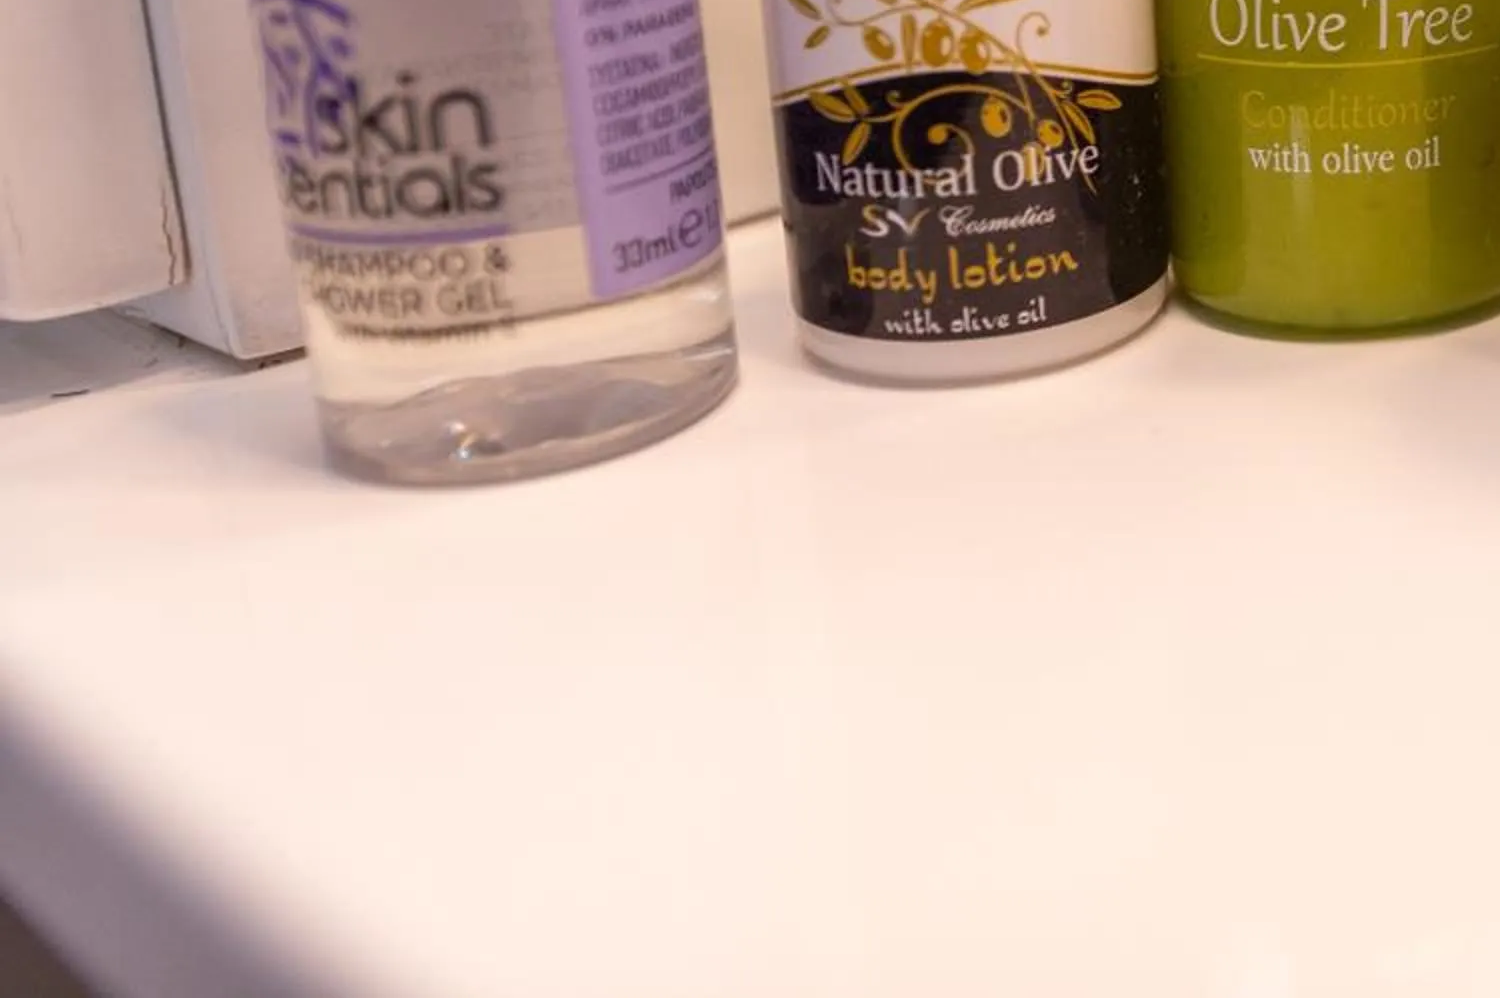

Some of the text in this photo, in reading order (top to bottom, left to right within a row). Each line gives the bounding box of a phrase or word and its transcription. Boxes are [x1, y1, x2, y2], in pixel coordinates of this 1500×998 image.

[314, 68, 493, 154] skin
[1242, 88, 1456, 131] Conditioner
[814, 144, 1100, 199] Natural Olive
[1248, 136, 1441, 174] with olive oil
[938, 204, 1057, 238] Cosmetics
[845, 241, 1079, 304] body lotion
[883, 297, 1048, 336] with olive oil
